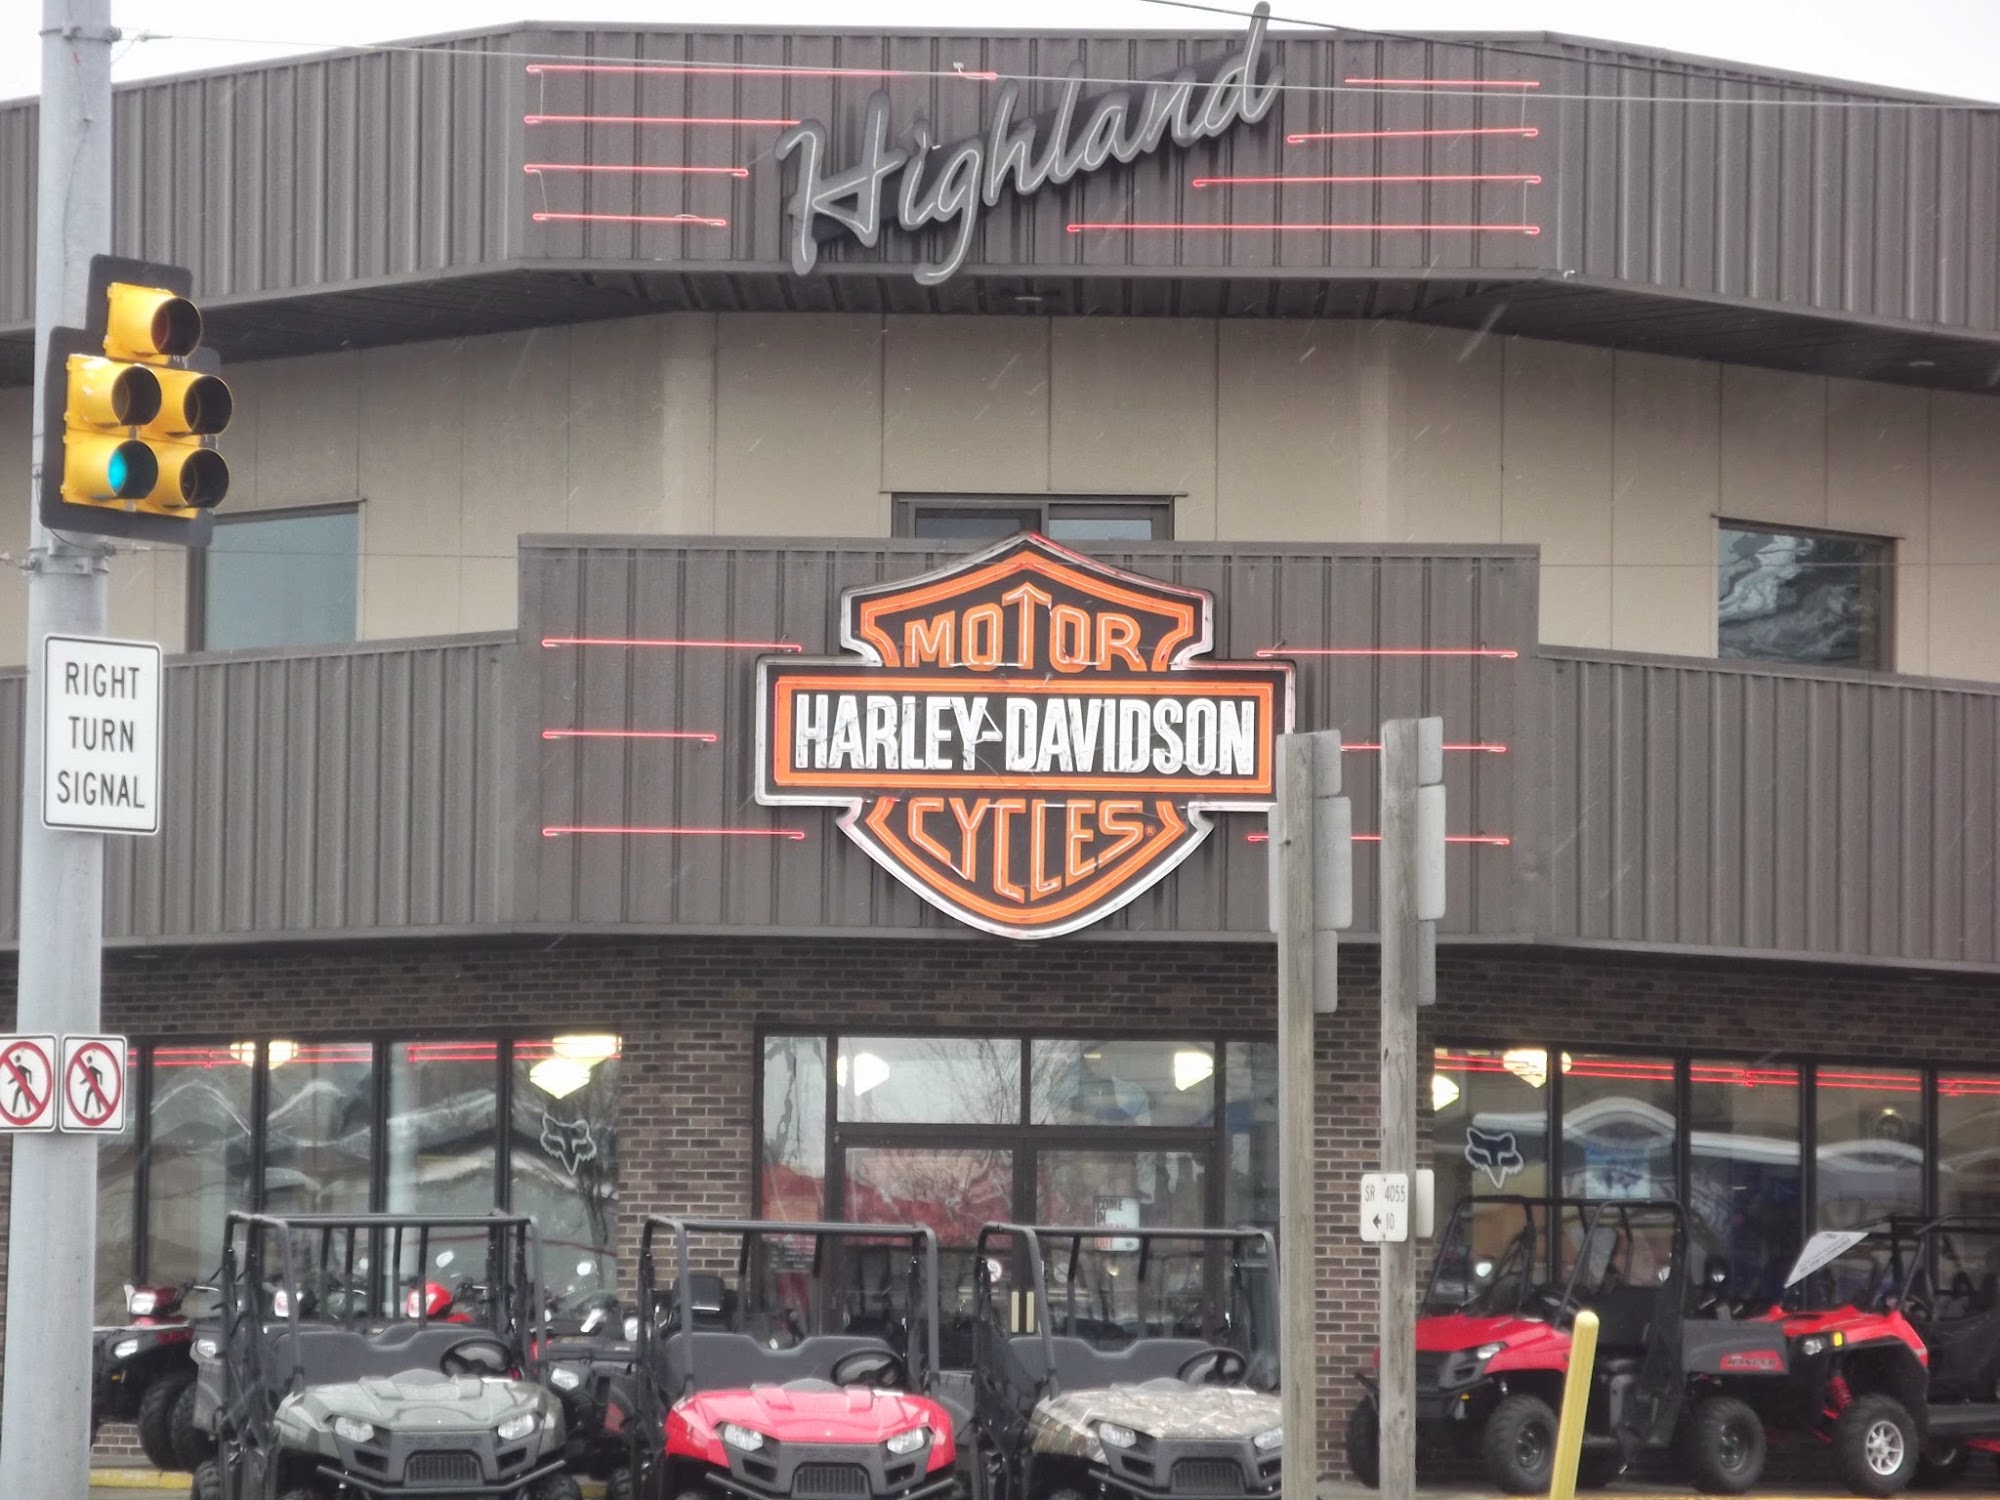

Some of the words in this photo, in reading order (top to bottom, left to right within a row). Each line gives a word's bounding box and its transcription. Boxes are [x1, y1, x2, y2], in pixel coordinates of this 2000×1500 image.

[775, 1, 1285, 285] Highland
[904, 582, 1147, 672] MOTOR
[65, 661, 140, 699] RIGHT
[68, 716, 134, 753] TURN
[794, 693, 1256, 775] HARLEY-DAVIDSON
[57, 769, 145, 809] SIGNAL
[907, 796, 1144, 904] CYCLES
[1365, 1184, 1376, 1203] SR
[1384, 1184, 1406, 1203] 4055
[1386, 1212, 1395, 1231] 10
